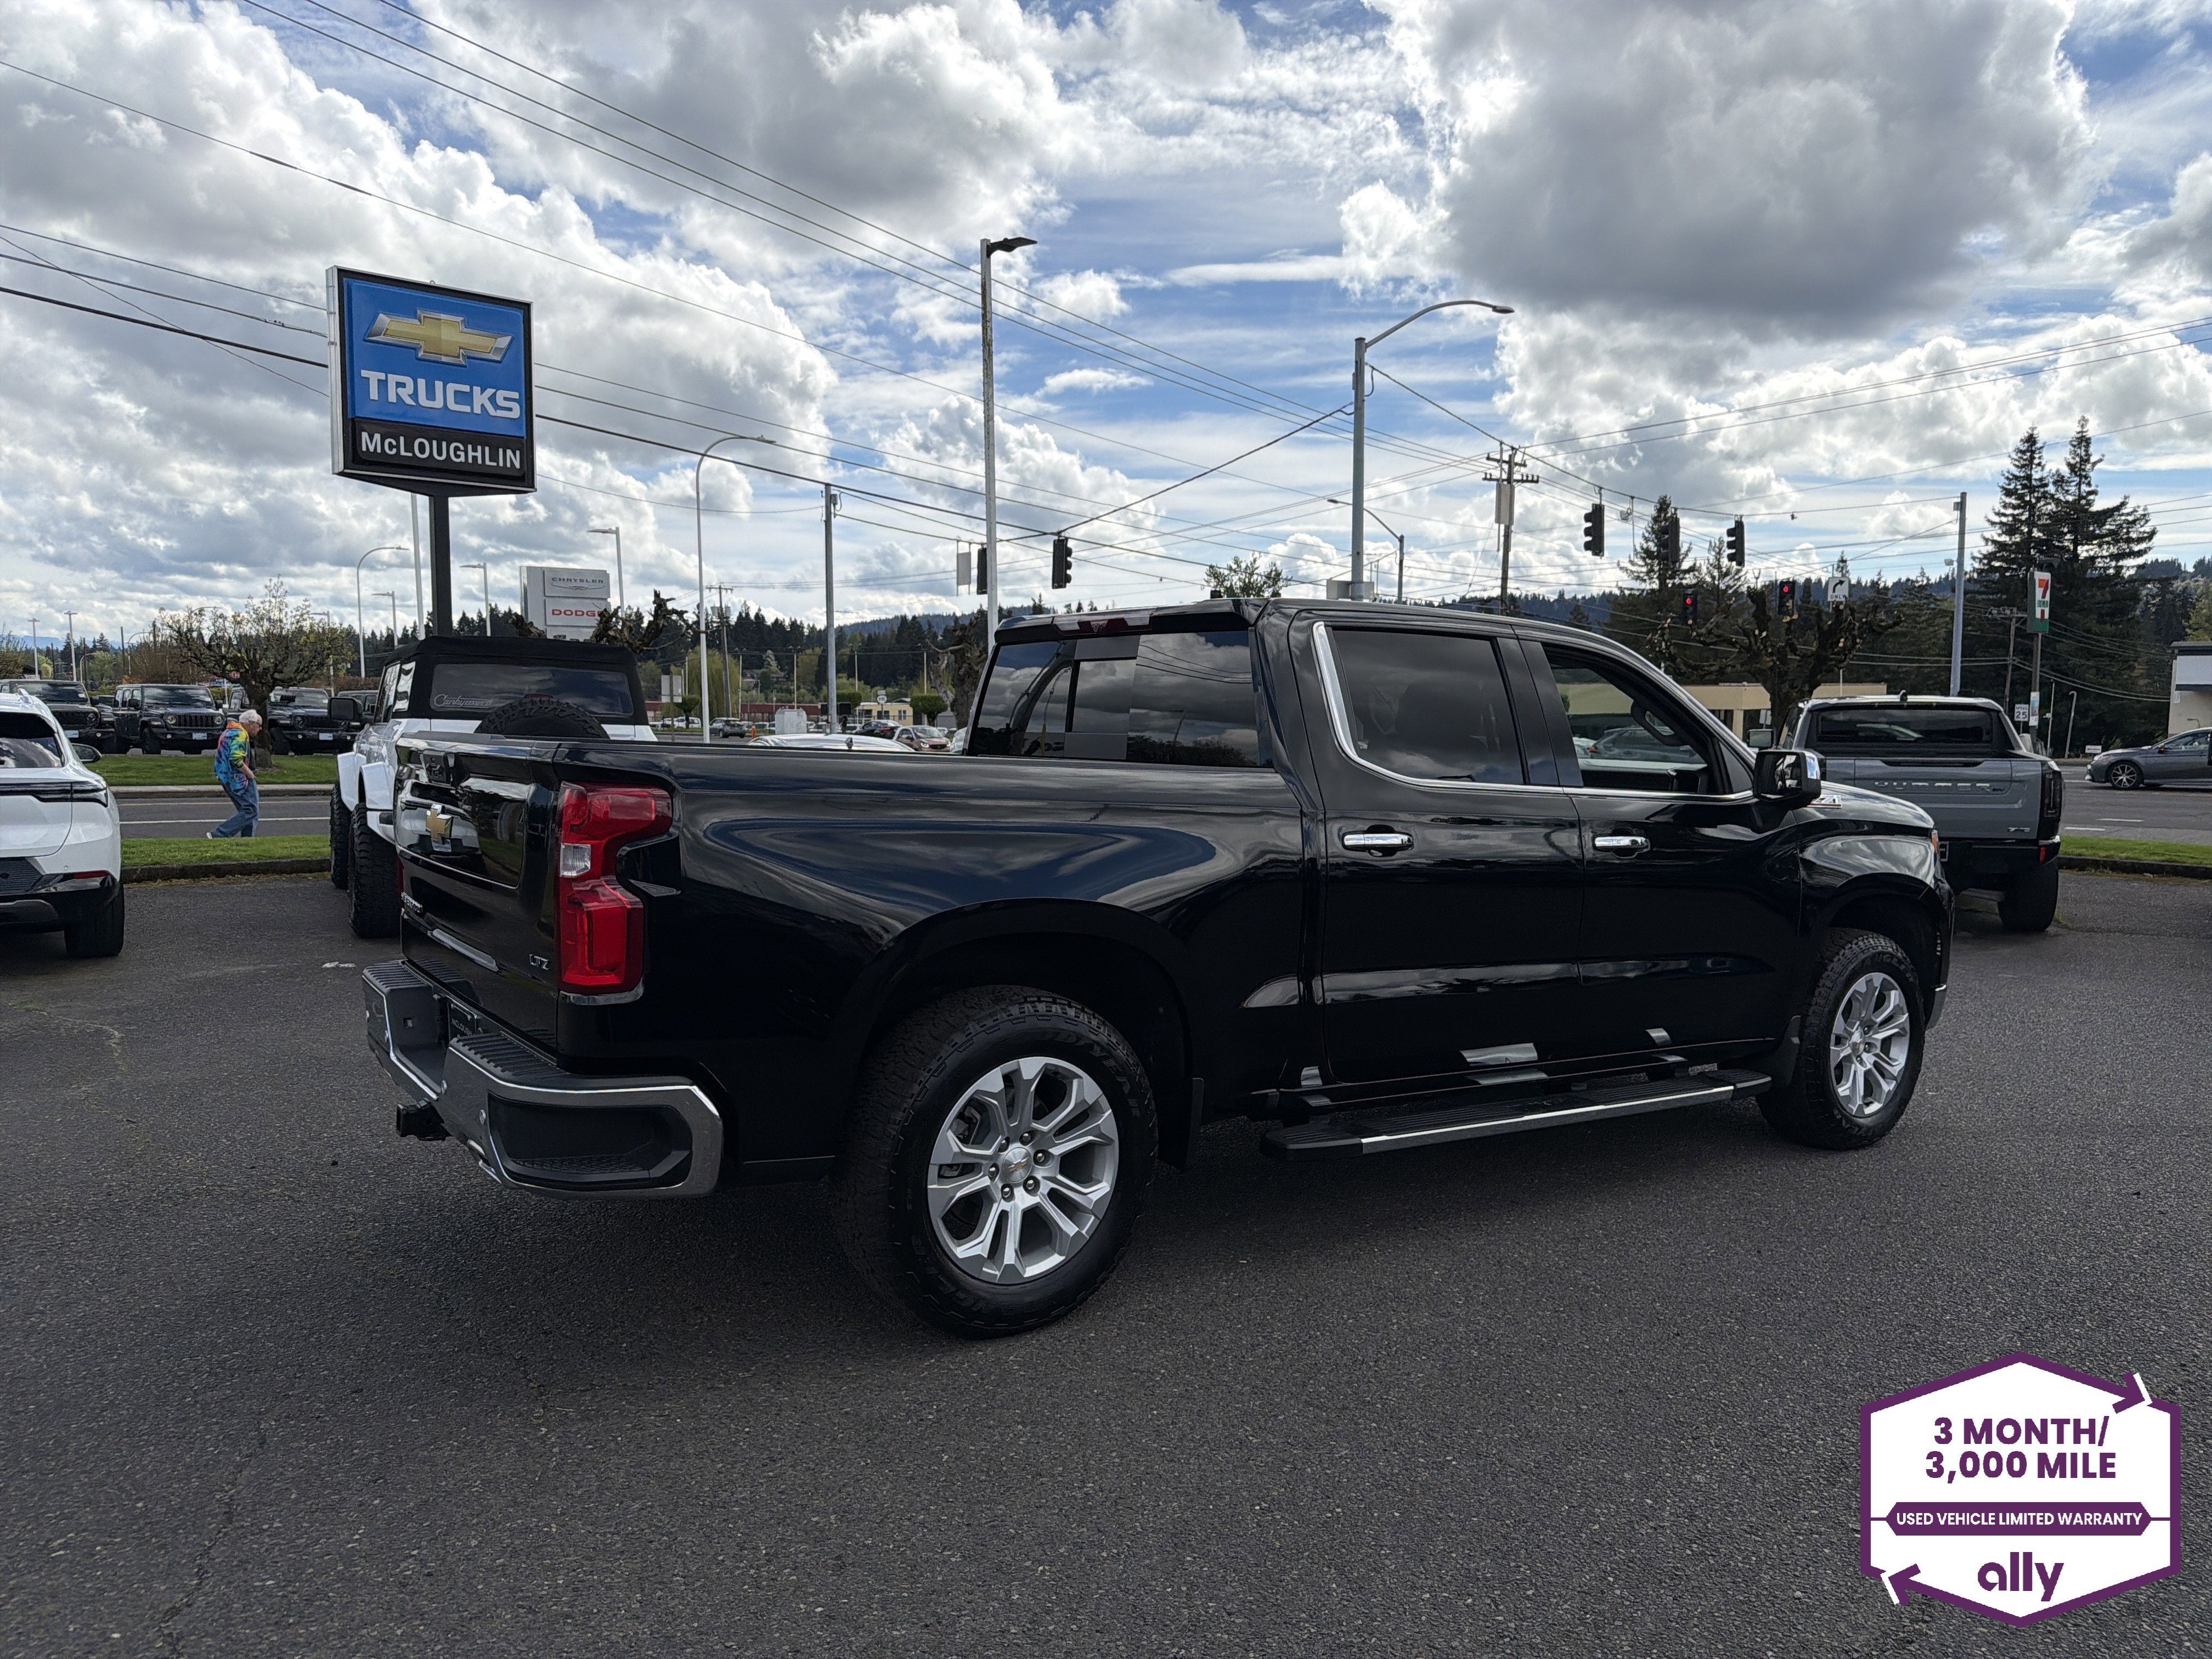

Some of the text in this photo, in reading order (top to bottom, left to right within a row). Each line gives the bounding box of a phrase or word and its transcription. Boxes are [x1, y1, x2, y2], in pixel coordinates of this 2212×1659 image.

[360, 370, 521, 419] TRUCKS
[361, 432, 521, 469] McLOUGHLIN
[2016, 711, 2028, 719] 25
[529, 954, 550, 970] LTZ
